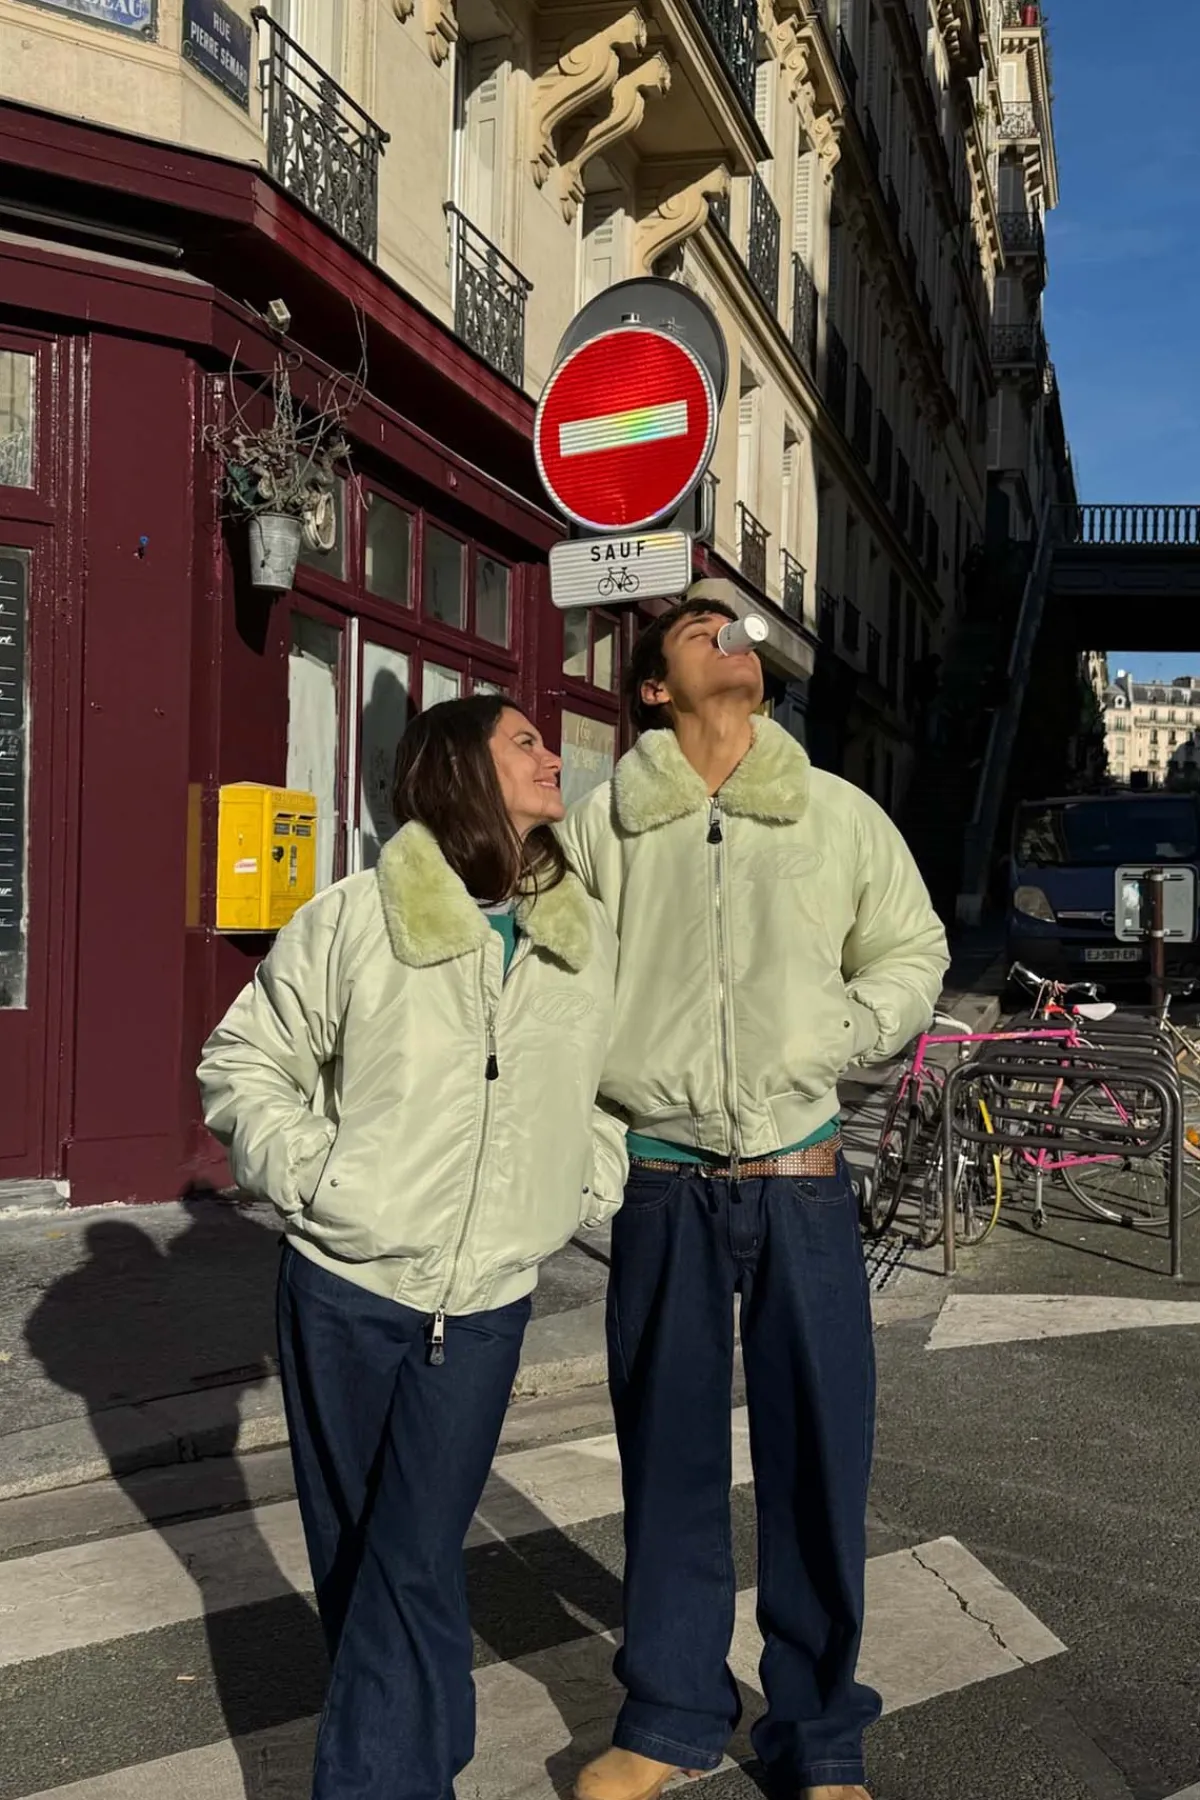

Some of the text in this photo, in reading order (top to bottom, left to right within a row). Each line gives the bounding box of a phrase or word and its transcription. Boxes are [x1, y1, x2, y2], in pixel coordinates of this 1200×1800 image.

[191, 20, 219, 60] PIERRE
[213, 11, 231, 43] RUE
[590, 540, 646, 562] SAUF
